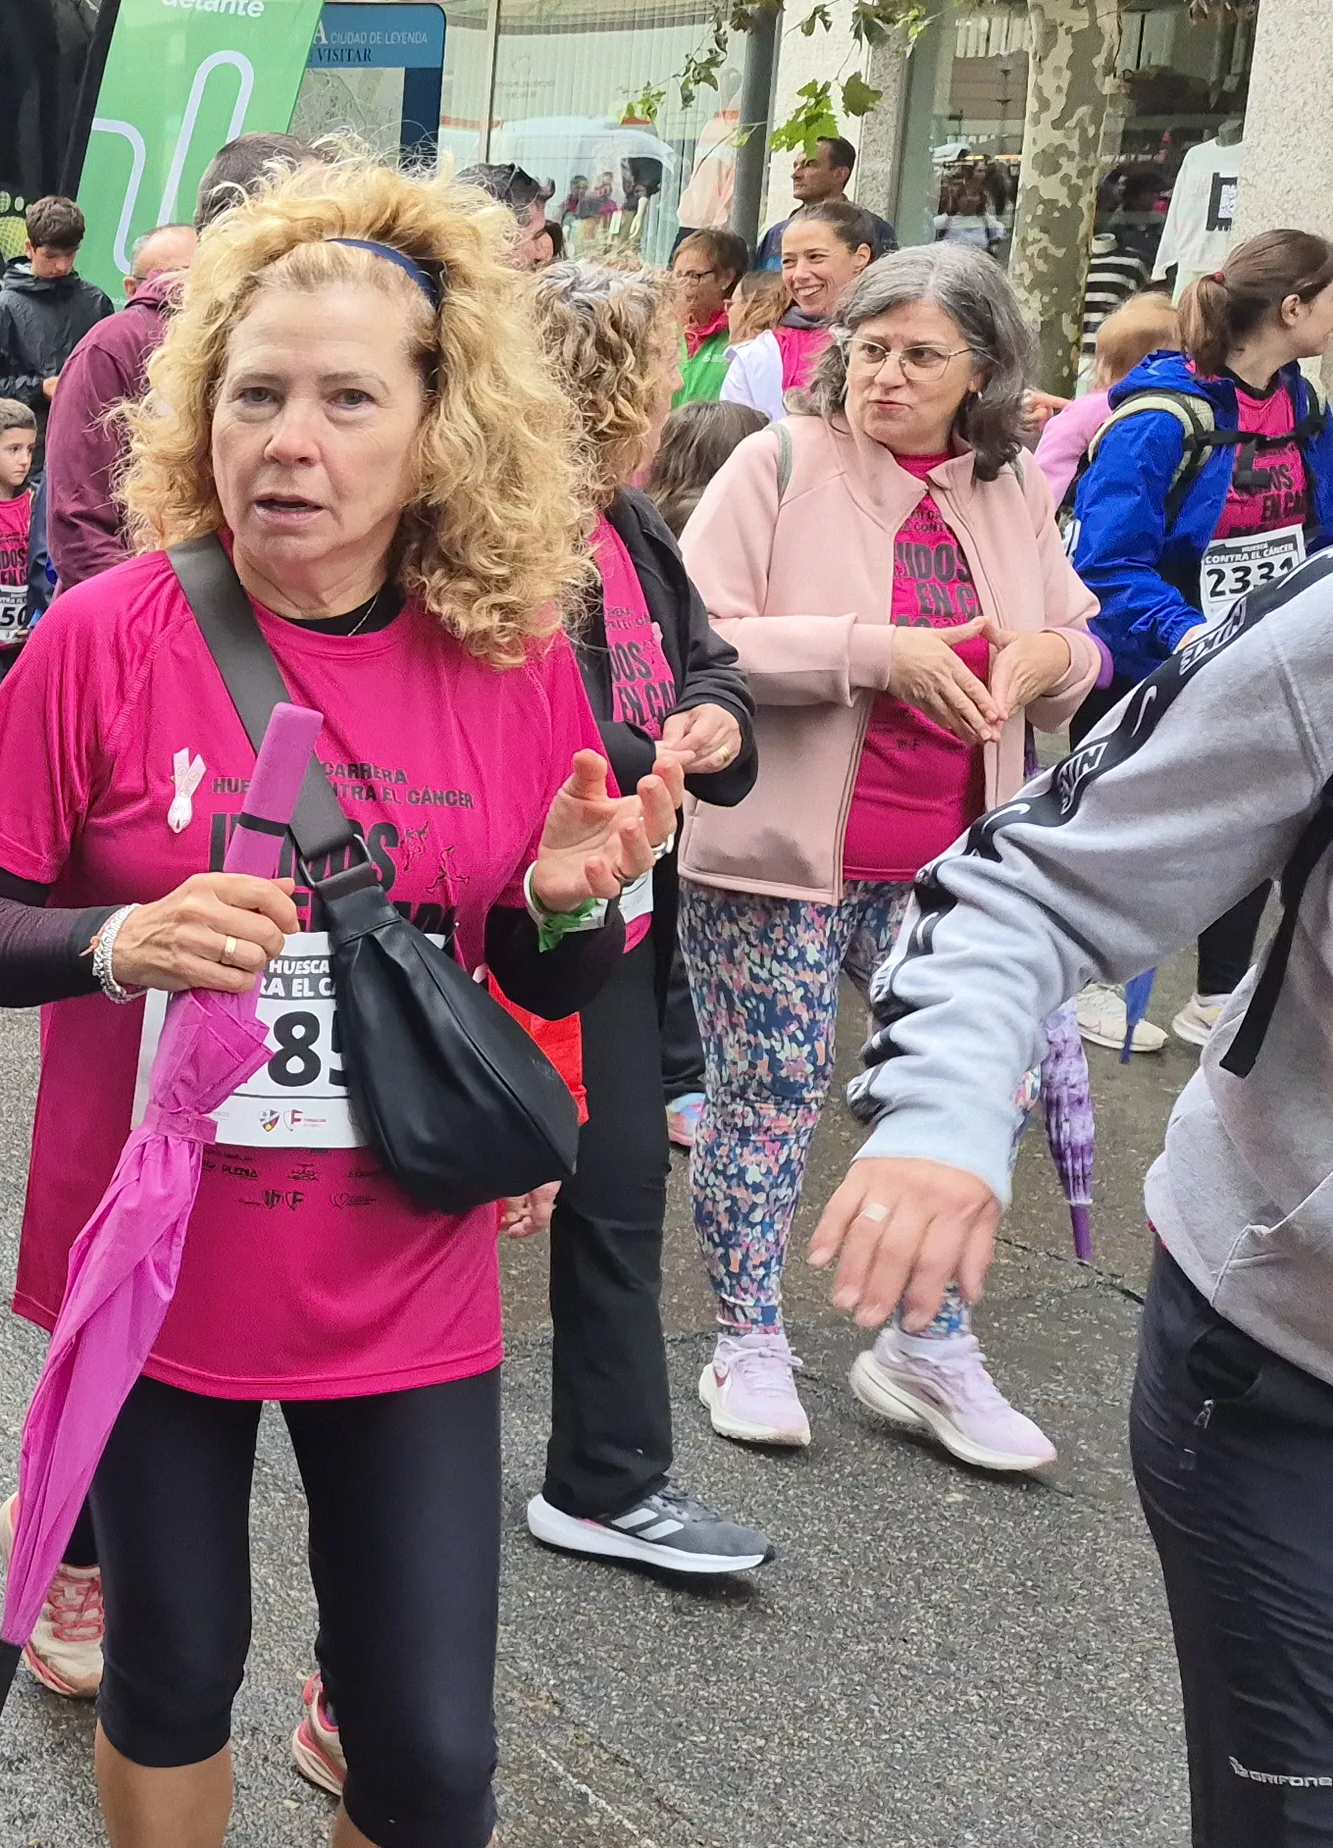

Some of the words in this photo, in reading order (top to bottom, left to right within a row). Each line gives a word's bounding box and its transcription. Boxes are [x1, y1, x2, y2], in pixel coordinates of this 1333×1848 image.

[331, 31, 367, 45] CIUDAD
[369, 32, 382, 45] DE
[385, 31, 428, 44] LEYENDA
[317, 48, 372, 62] VISITAR
[1205, 553, 1250, 564] CONTRA
[1251, 552, 1262, 560] EL
[1264, 543, 1295, 556] CÁNCER
[915, 582, 955, 617] EN
[321, 761, 408, 785] CARRERA
[382, 787, 403, 805] EL
[407, 785, 475, 809] CÁNCER
[268, 958, 330, 975] HUESCA
[291, 978, 315, 998] EL
